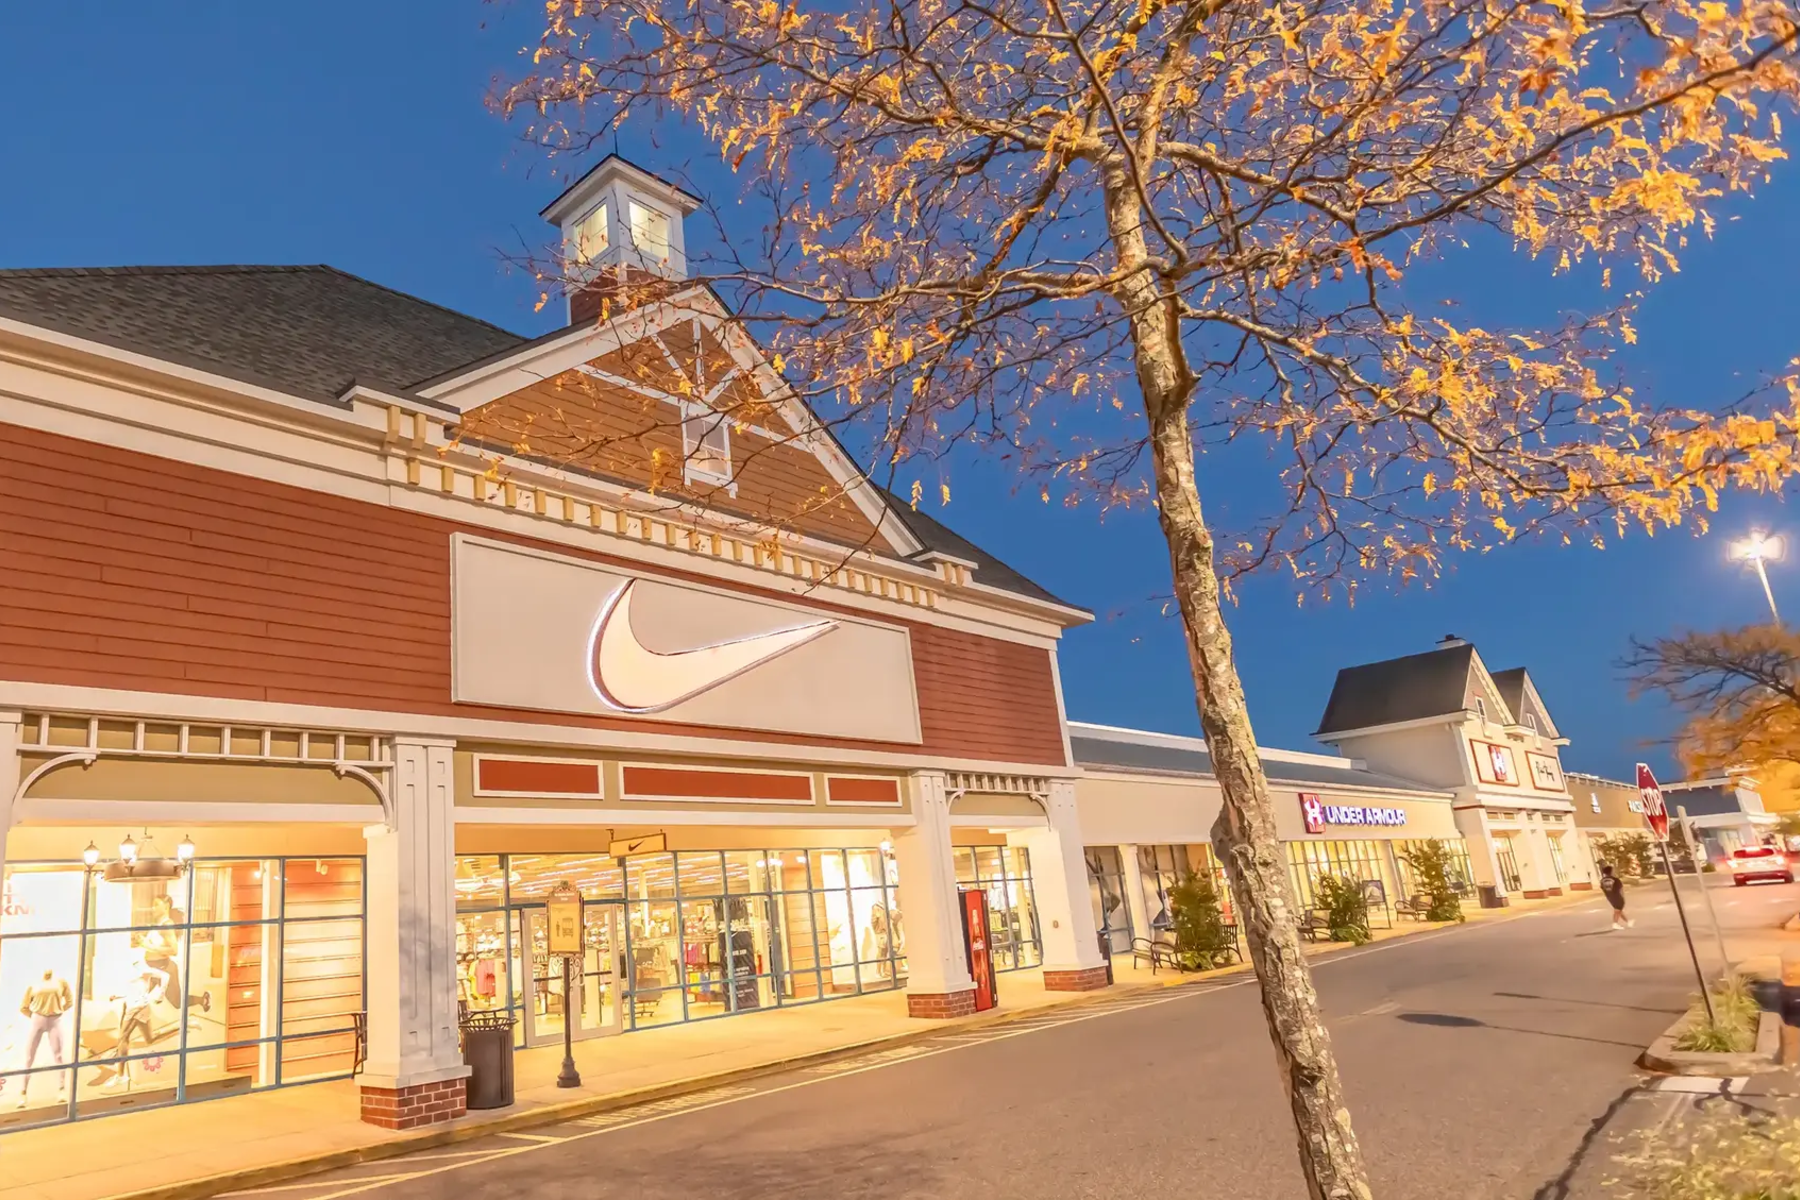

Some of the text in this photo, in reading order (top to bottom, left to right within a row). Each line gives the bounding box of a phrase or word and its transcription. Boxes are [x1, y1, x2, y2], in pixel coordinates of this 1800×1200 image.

[1641, 787, 1663, 816] STOP
[1323, 805, 1406, 826] UNDER ARMOUR
